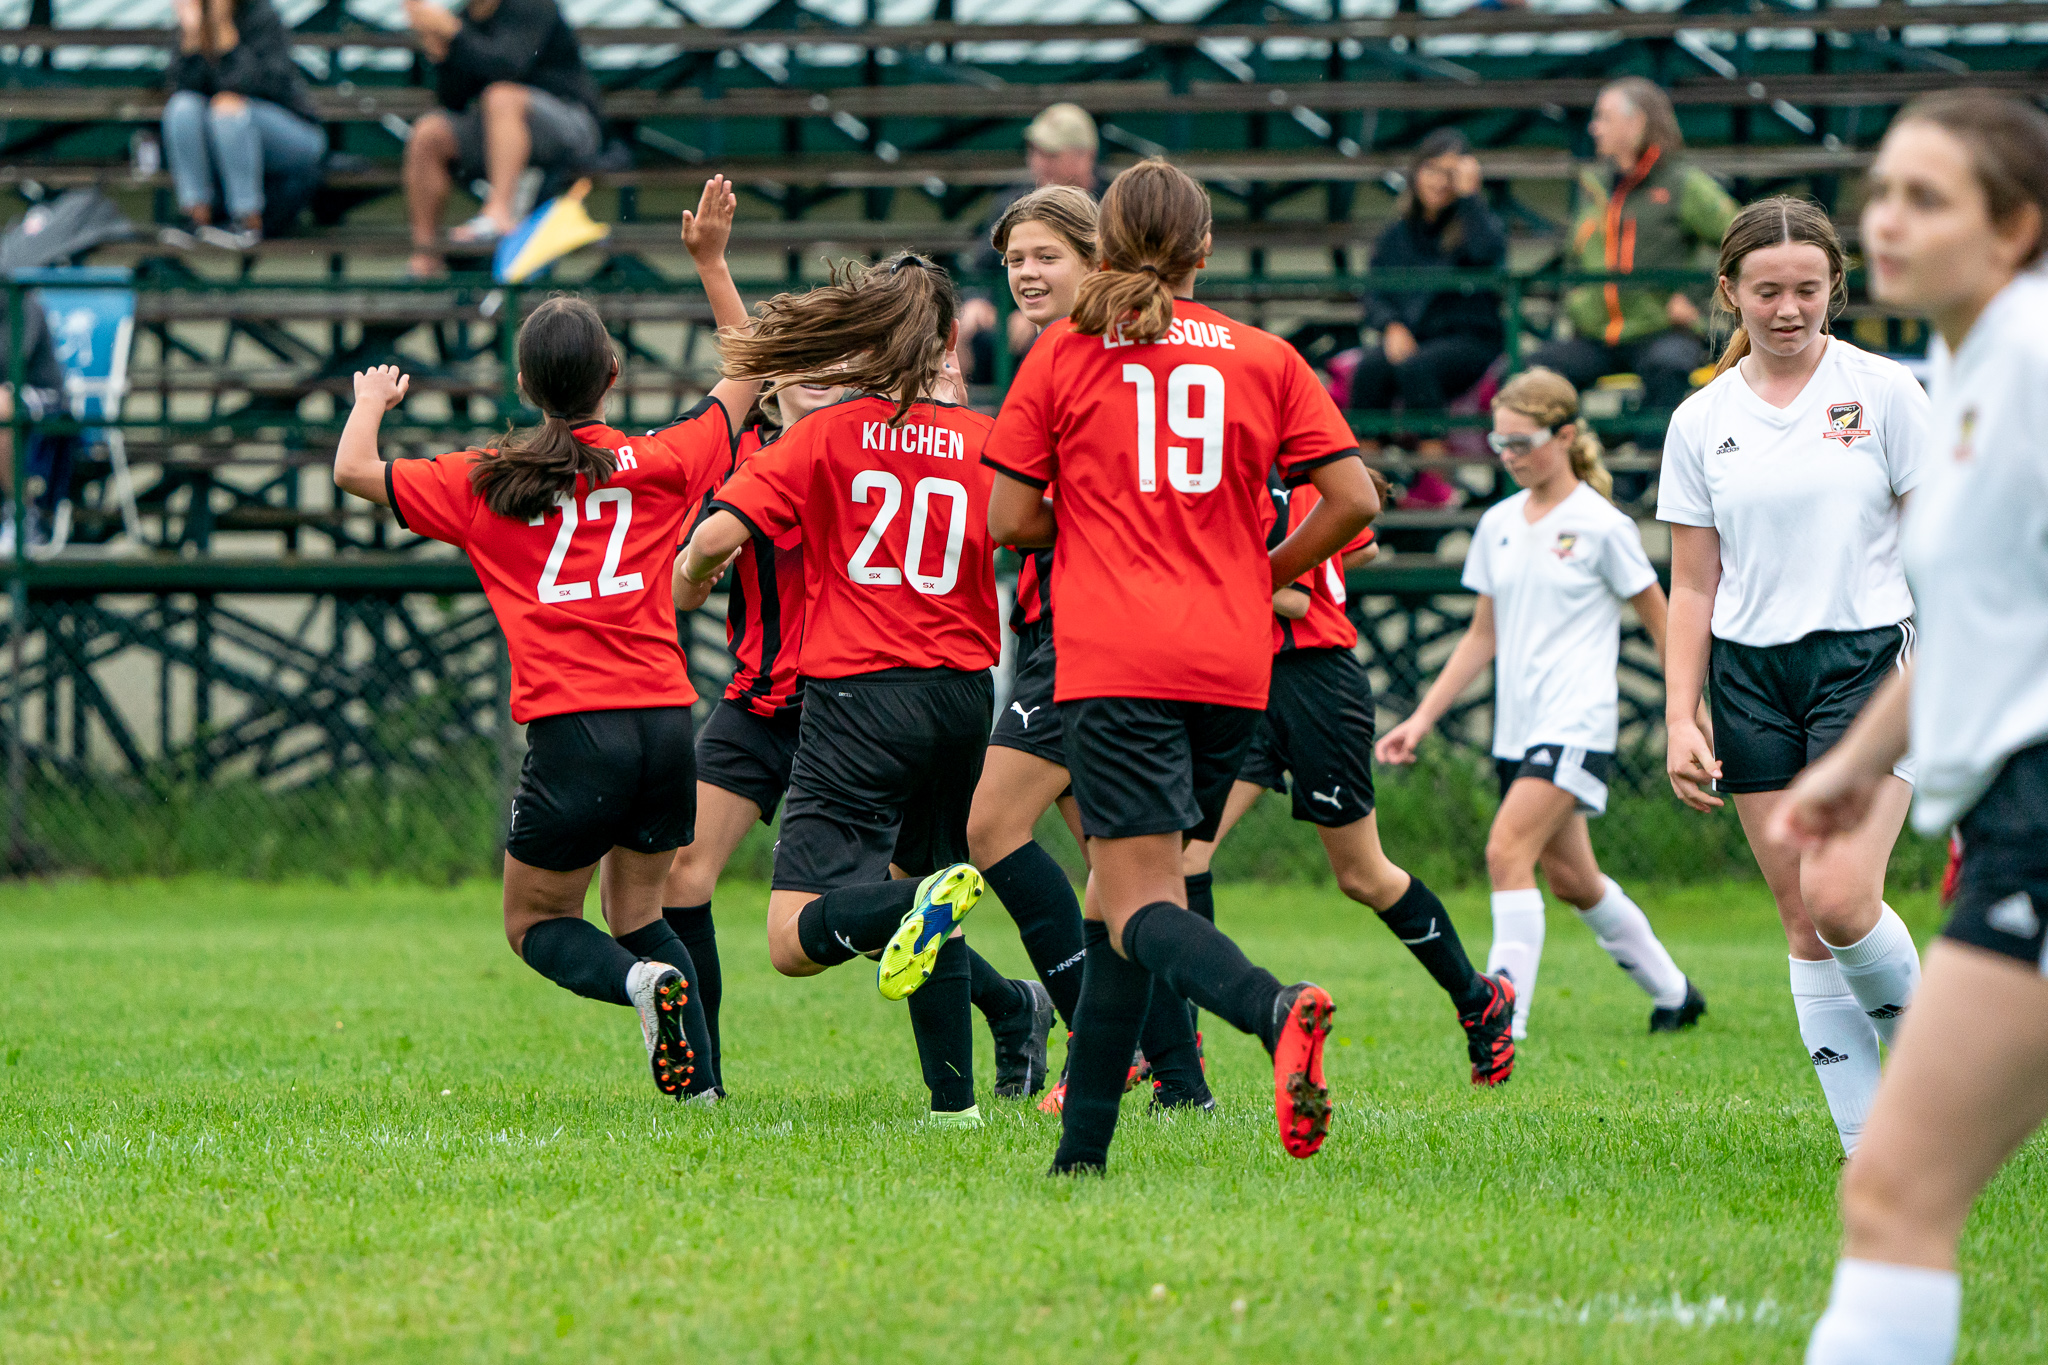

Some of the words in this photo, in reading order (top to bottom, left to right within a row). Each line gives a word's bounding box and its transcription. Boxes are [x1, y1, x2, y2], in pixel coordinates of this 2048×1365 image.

[1102, 317, 1236, 350] LESQUE
[862, 421, 964, 461] KITCHEN
[1122, 363, 1225, 493] 19
[1716, 446, 1740, 455] adidas
[528, 487, 644, 604] 22
[847, 469, 968, 595] 20
[558, 589, 571, 597] SX
